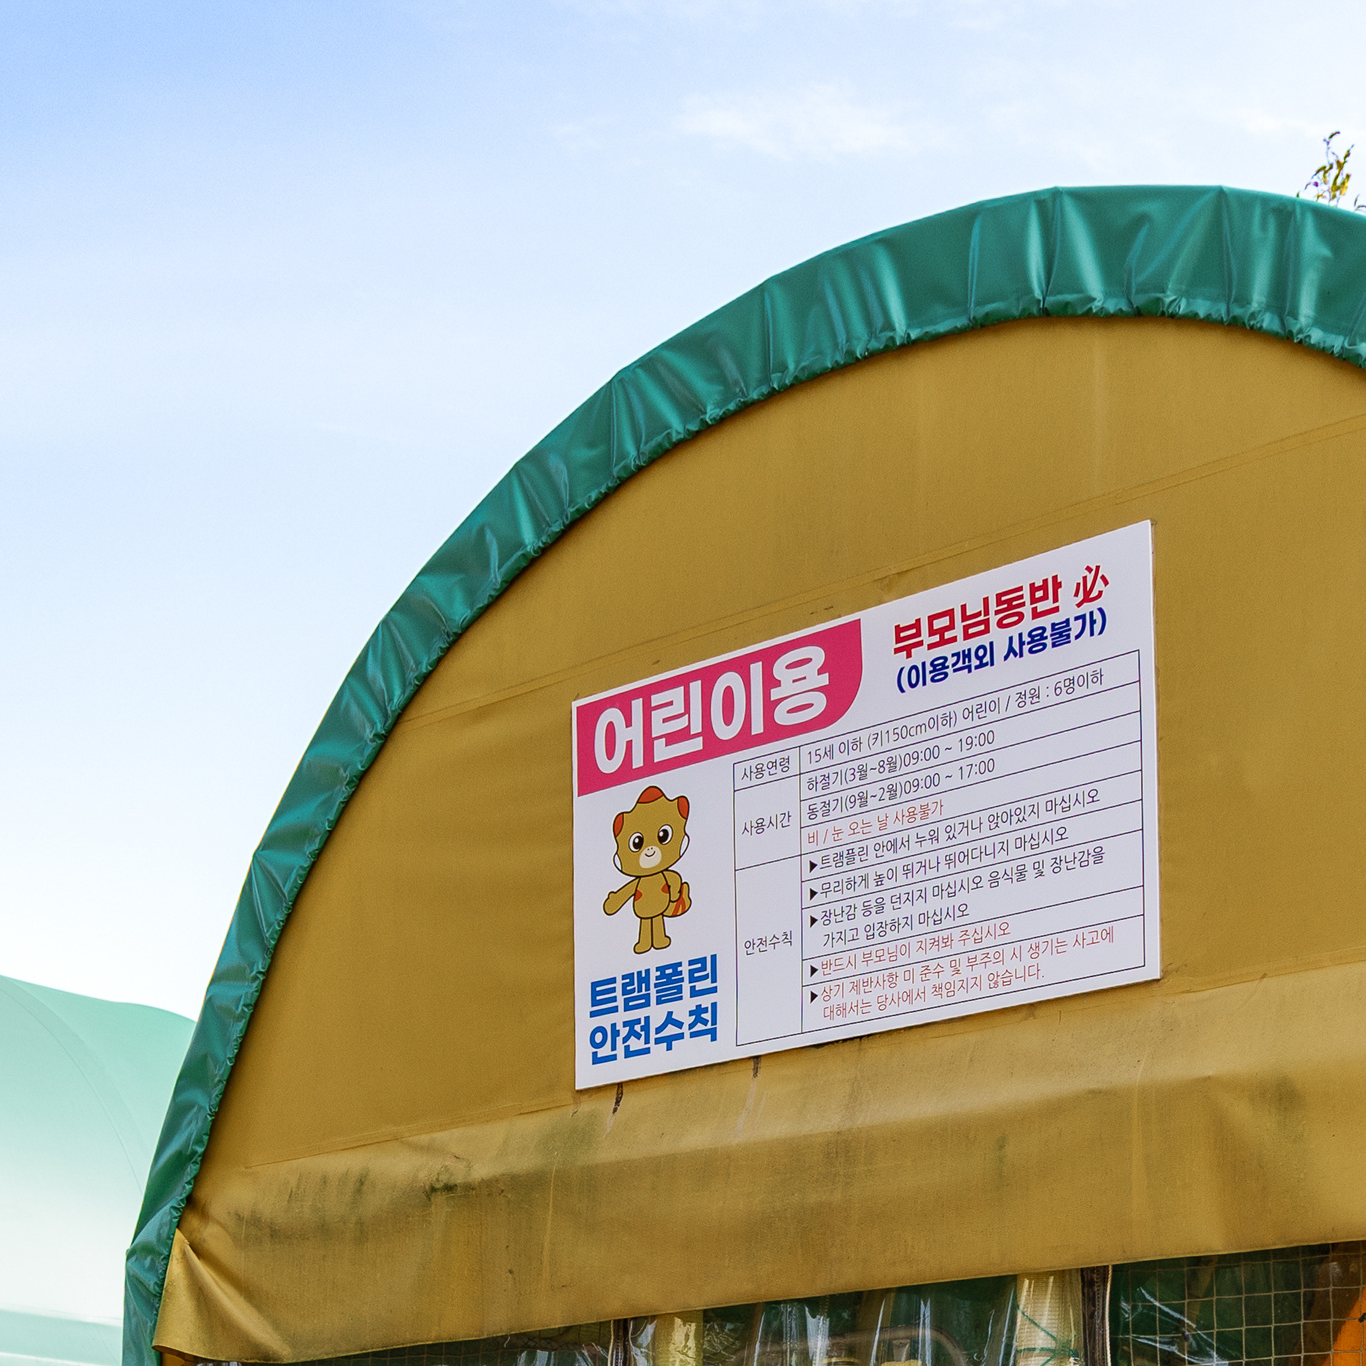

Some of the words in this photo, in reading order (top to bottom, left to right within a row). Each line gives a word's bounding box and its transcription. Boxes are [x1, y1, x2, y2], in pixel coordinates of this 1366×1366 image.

[893, 575, 1062, 659] 부모님동반
[1073, 564, 1110, 609] 必
[896, 640, 995, 694] (이용객외
[1002, 608, 1108, 662] 사용불가)
[594, 645, 830, 775] 어린이용
[807, 744, 834, 765] 15세
[839, 737, 863, 756] 이하
[867, 711, 958, 750] (키150cm이하)
[962, 697, 1001, 722] 어린이
[1015, 686, 1041, 708] 정원
[1054, 668, 1104, 697] 6명이하
[958, 730, 995, 752] 19:00
[741, 756, 791, 782] 사용연령
[958, 758, 995, 780] 17:00
[741, 811, 792, 836] 사용시간
[807, 831, 819, 846] 비
[832, 826, 844, 842] 눈
[848, 818, 873, 837] 오는
[877, 812, 889, 831] 날
[893, 799, 944, 825] 사용불가
[873, 835, 910, 858] 안에서
[915, 827, 939, 848] 누워
[944, 817, 983, 841] 있거나
[987, 802, 1040, 831] 앉아있지
[1045, 788, 1100, 815] 마십시오
[820, 873, 870, 899] 무리하게
[873, 865, 898, 886] 높이
[902, 855, 941, 880] 뛰거나
[944, 838, 1010, 870] 뛰어다니지
[1014, 826, 1069, 851] 마십시오
[820, 903, 857, 926] 장난감
[861, 896, 885, 916] 등을
[890, 887, 927, 911] 던지지
[932, 875, 984, 900] 마십시오
[988, 863, 1028, 889] 음식물
[1033, 859, 1045, 879] 및
[1050, 845, 1105, 874] 장난감을
[744, 930, 793, 956] 안전수칙
[820, 953, 857, 976] 반드시
[861, 941, 911, 967] 부모님이
[916, 932, 954, 955] 지켜봐
[957, 921, 1011, 947] 주십시오
[823, 928, 860, 948] 가지고
[864, 914, 913, 941] 입장하지
[918, 903, 970, 928] 마십시오
[589, 953, 718, 1018] 트램폴린
[820, 983, 845, 1002] 상기
[848, 971, 899, 996] 제반사항
[903, 968, 915, 984] 미
[919, 962, 945, 982] 준수
[949, 957, 961, 976] 및
[966, 948, 1005, 972] 부주의
[1010, 945, 1022, 962] 시
[1027, 937, 1068, 960] 생기는
[1072, 926, 1114, 949] 사고에
[823, 999, 872, 1021] 대해서는
[877, 986, 926, 1011] 당사에서
[931, 976, 983, 1000] 책임지지
[987, 962, 1045, 989] 않습니다.
[589, 1001, 718, 1066] 안전수칙
